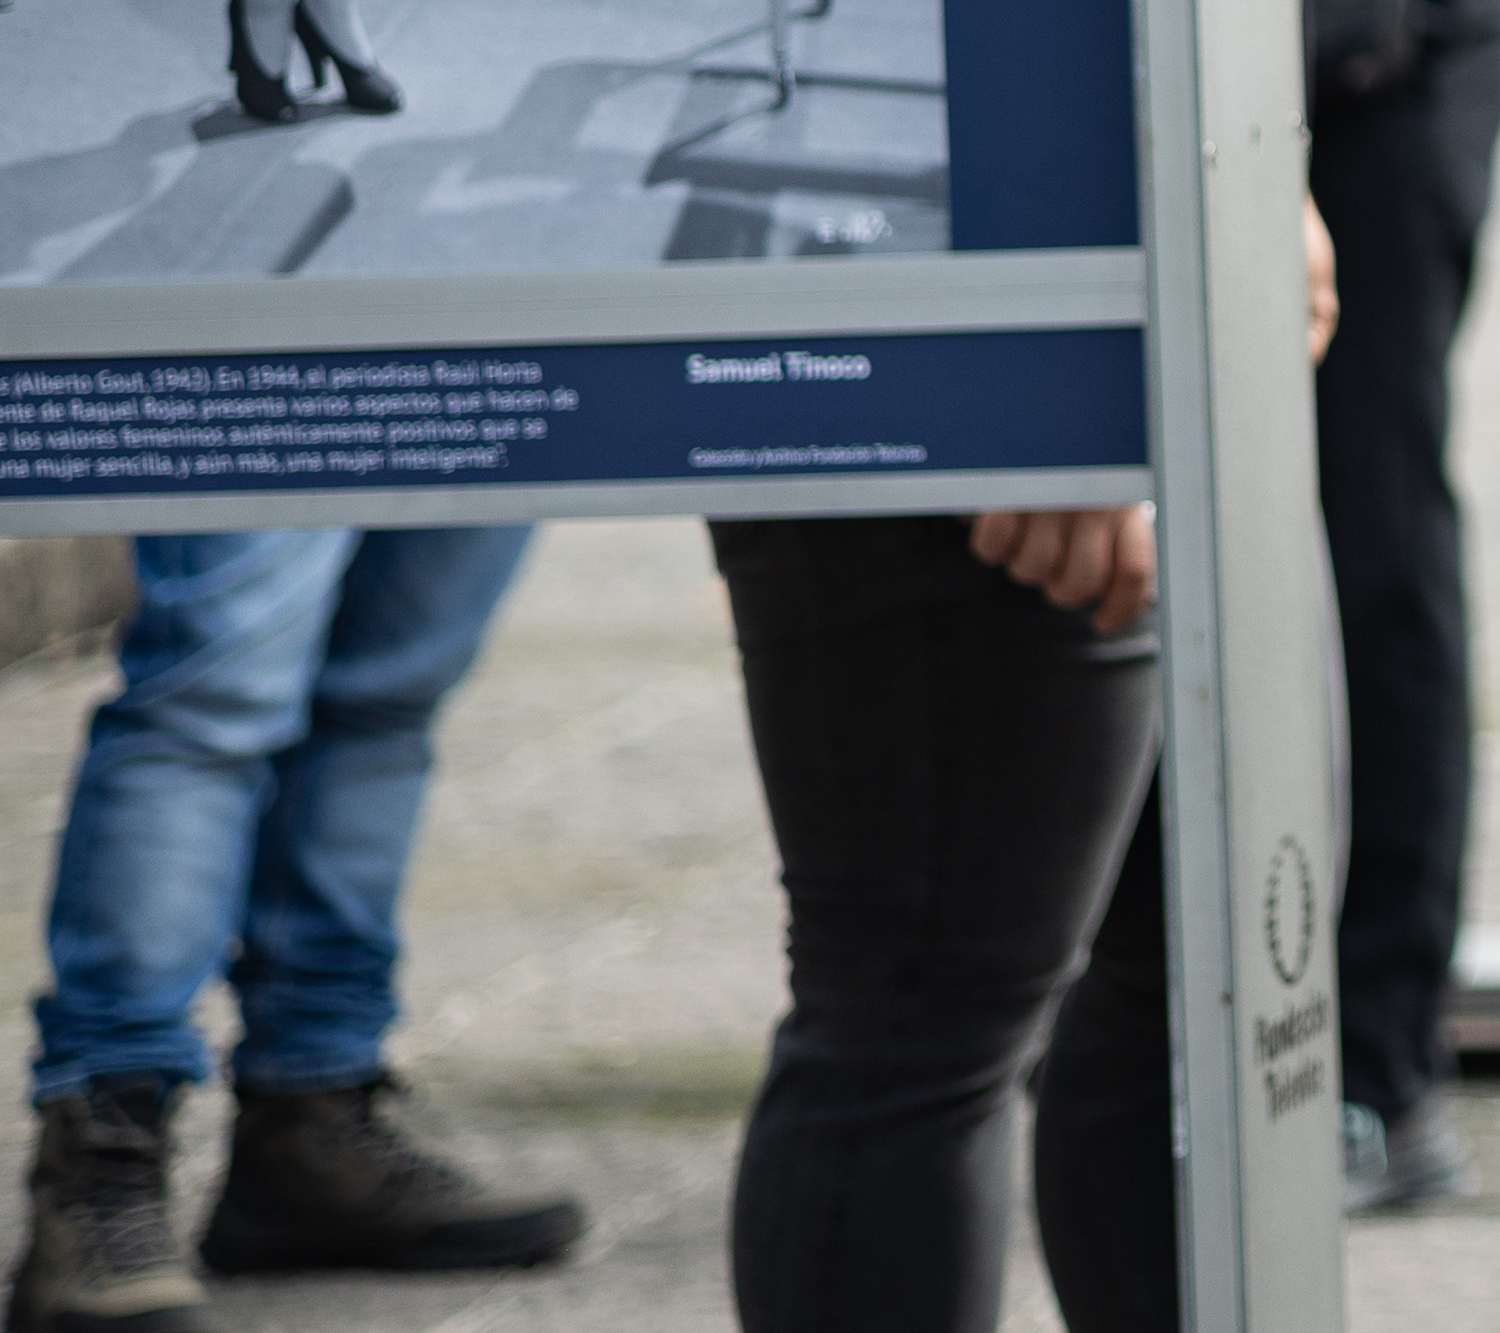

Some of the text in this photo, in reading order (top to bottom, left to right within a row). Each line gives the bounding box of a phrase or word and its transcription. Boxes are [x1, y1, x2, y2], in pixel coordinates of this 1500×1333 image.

[213, 365, 245, 391] En
[303, 363, 327, 390] el
[328, 361, 431, 393] periodista
[431, 359, 480, 386] Raúl
[685, 351, 872, 383] Samuel Tinoco
[38, 399, 66, 423] de
[67, 397, 139, 425] Raquel
[140, 395, 197, 425] Rojas
[198, 395, 288, 424] presenta
[288, 391, 350, 417] varios
[352, 391, 443, 418] aspectos
[442, 390, 485, 417] que
[485, 387, 549, 412] hacen
[550, 385, 580, 412] de
[10, 428, 43, 451] los
[45, 426, 118, 451] valores
[119, 423, 225, 449] femeninos
[227, 419, 384, 447] auténticamente
[385, 416, 479, 444] positivos
[478, 417, 520, 444] que
[520, 416, 549, 440] se
[31, 454, 91, 482] mujer
[175, 453, 191, 480] y
[284, 449, 325, 474] una
[325, 446, 385, 475] mujer
